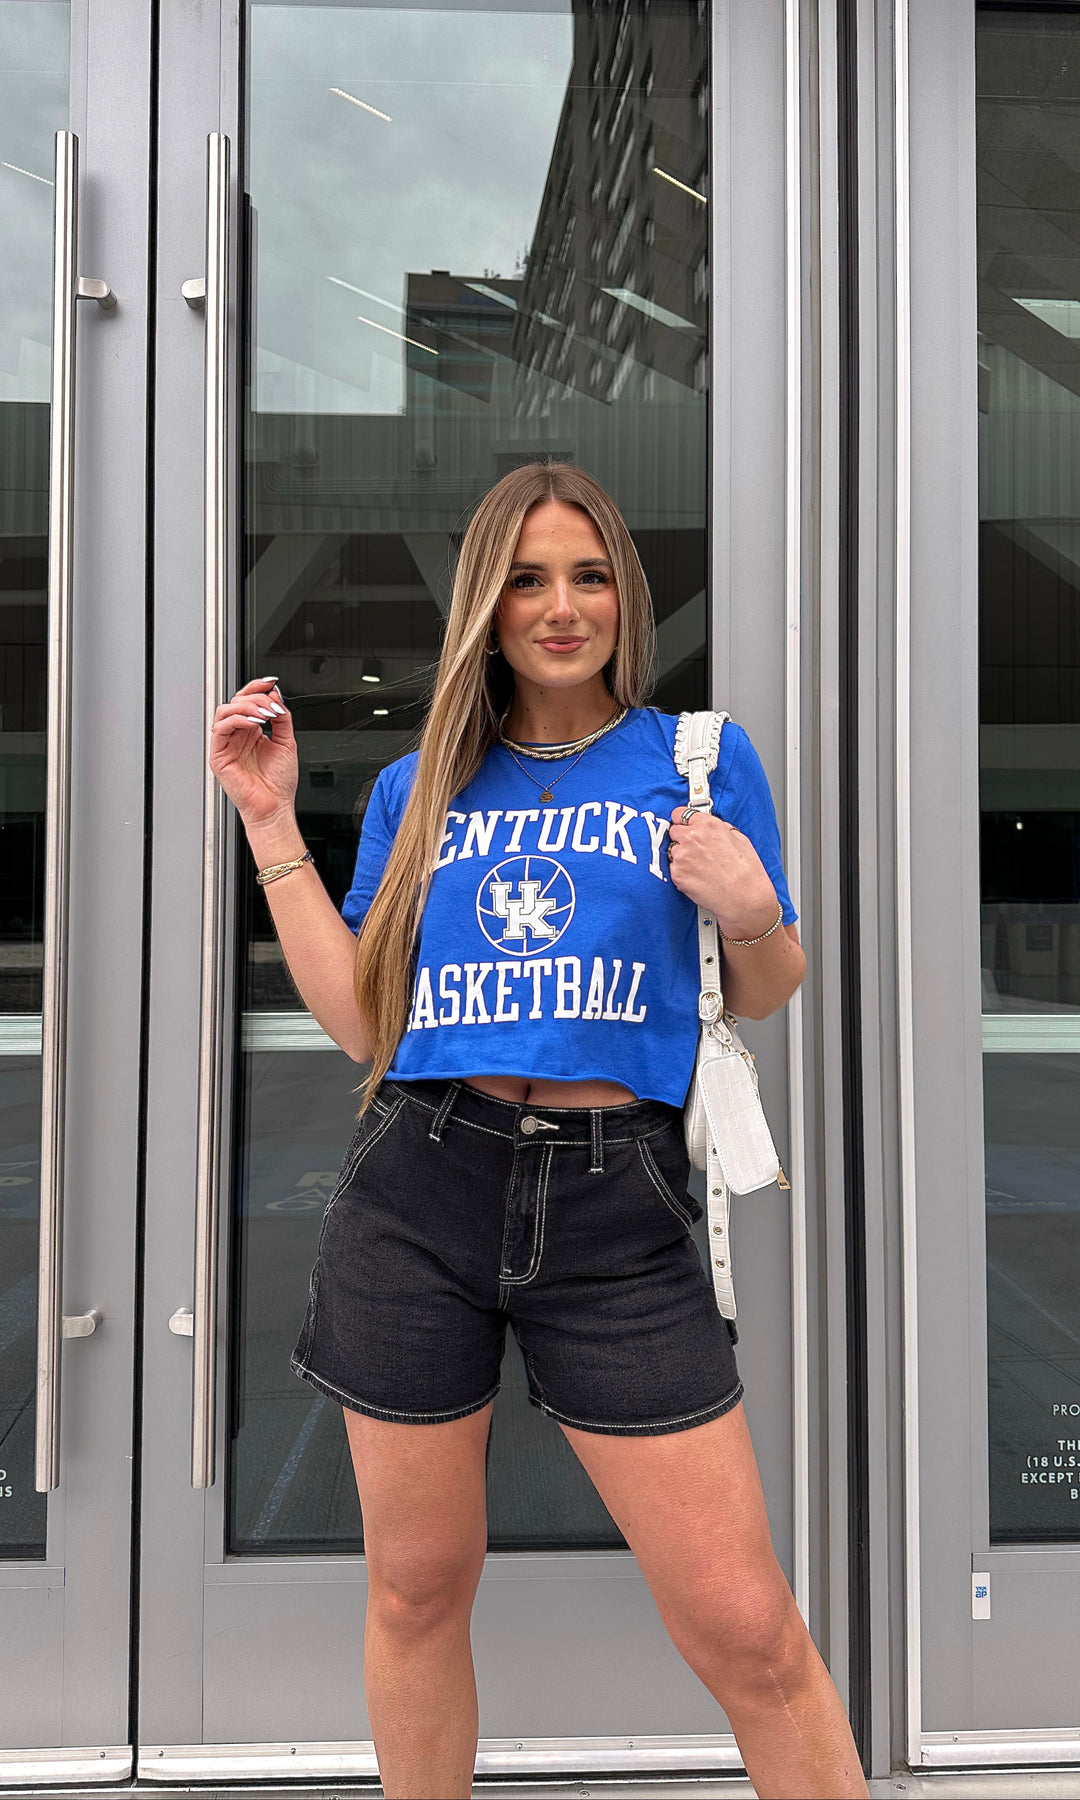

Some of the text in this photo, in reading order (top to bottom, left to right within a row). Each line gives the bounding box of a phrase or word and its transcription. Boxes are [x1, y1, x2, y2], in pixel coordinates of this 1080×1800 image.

[431, 801, 670, 882] ENTUCKY
[489, 880, 556, 940] UK
[406, 956, 647, 1034] ASKETBALL
[1021, 1472, 1074, 1484] EXCEPT
[1027, 1456, 1049, 1468] (18
